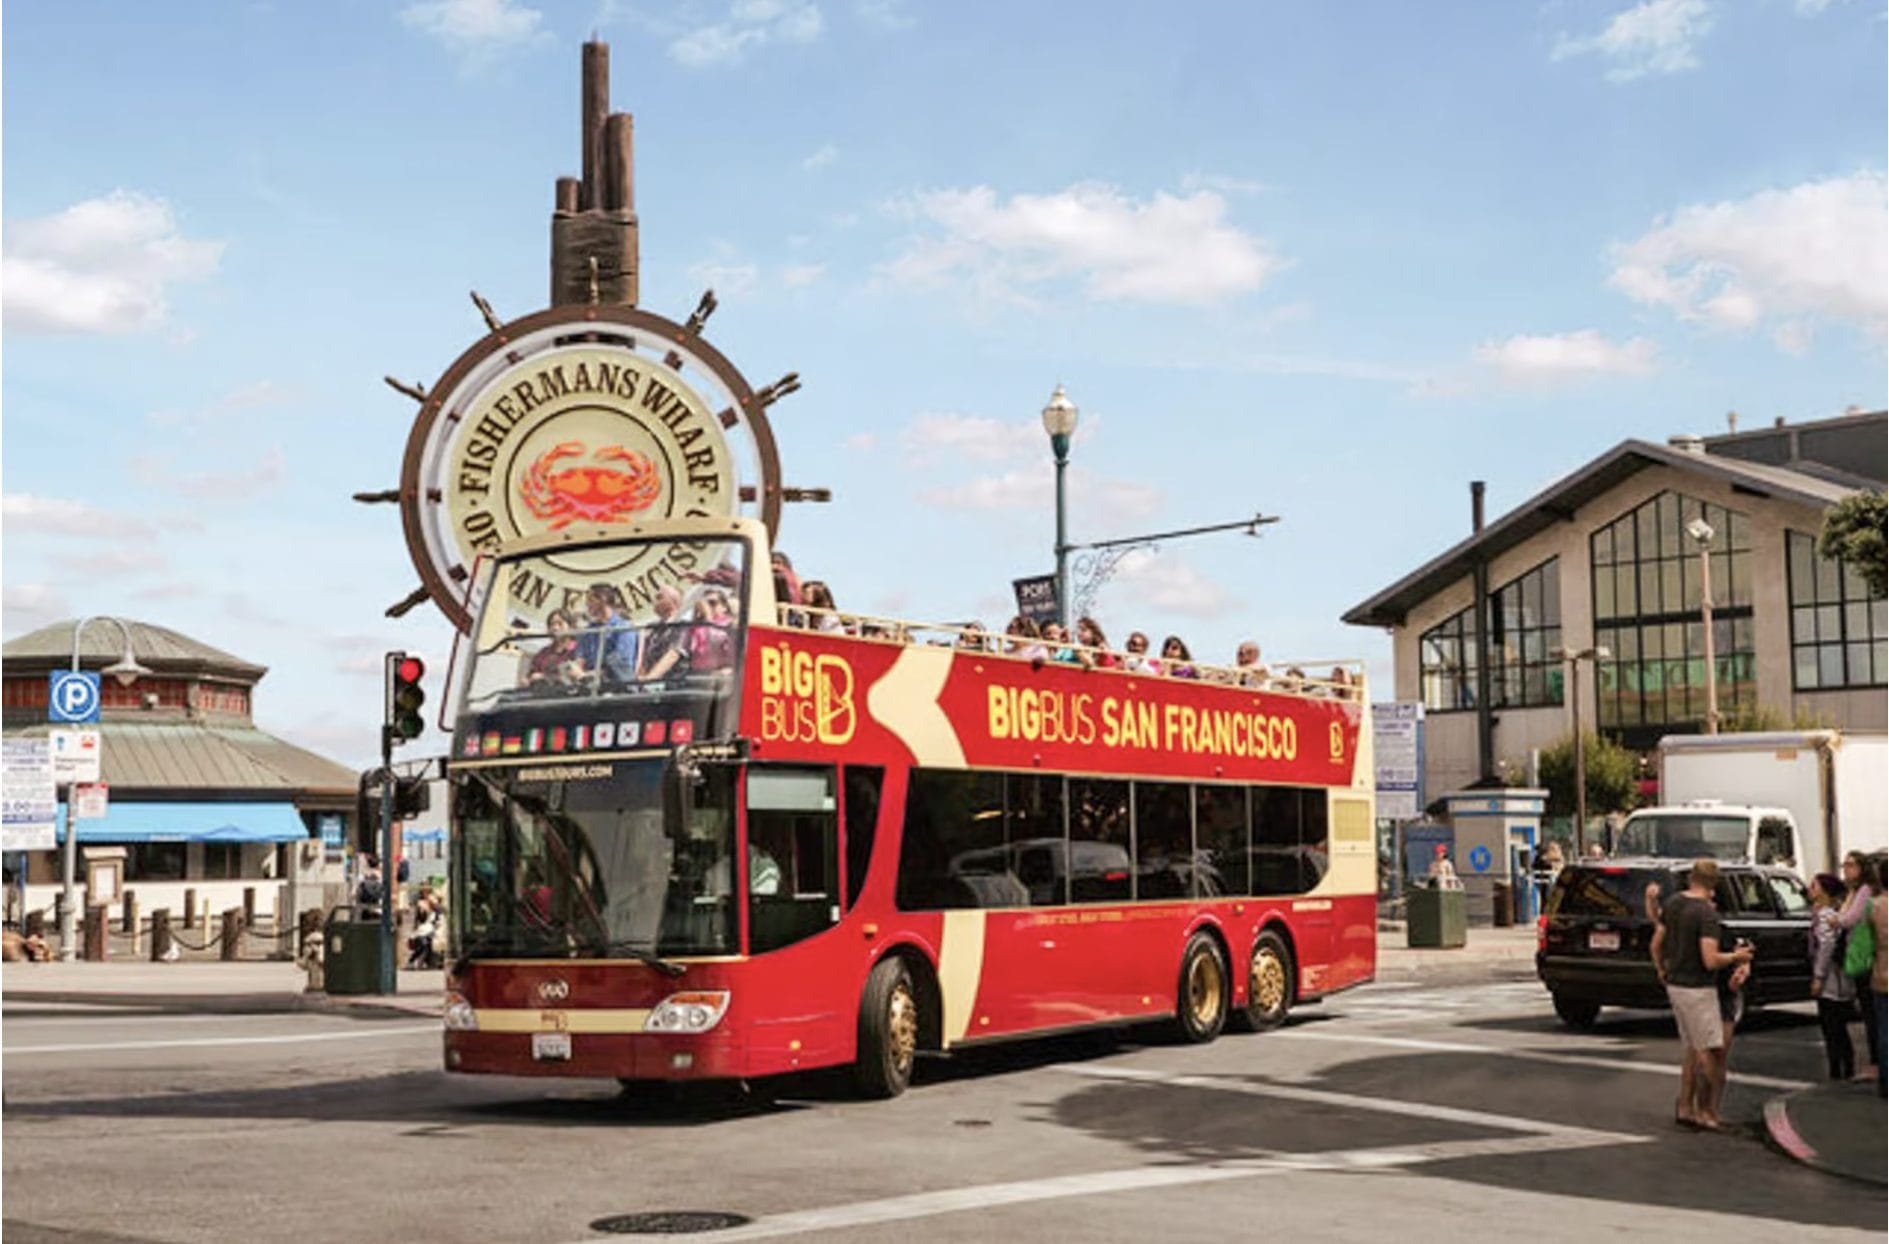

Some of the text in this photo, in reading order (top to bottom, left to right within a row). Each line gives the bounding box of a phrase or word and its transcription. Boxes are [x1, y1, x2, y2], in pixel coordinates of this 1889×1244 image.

[459, 362, 719, 496] FISHERMANS WHARF
[508, 561, 554, 609] AN
[65, 682, 88, 712] P
[761, 646, 814, 698] BIG
[762, 697, 817, 743] BUS
[1101, 697, 1159, 750] SAN
[1164, 703, 1297, 761] FRANCISCO
